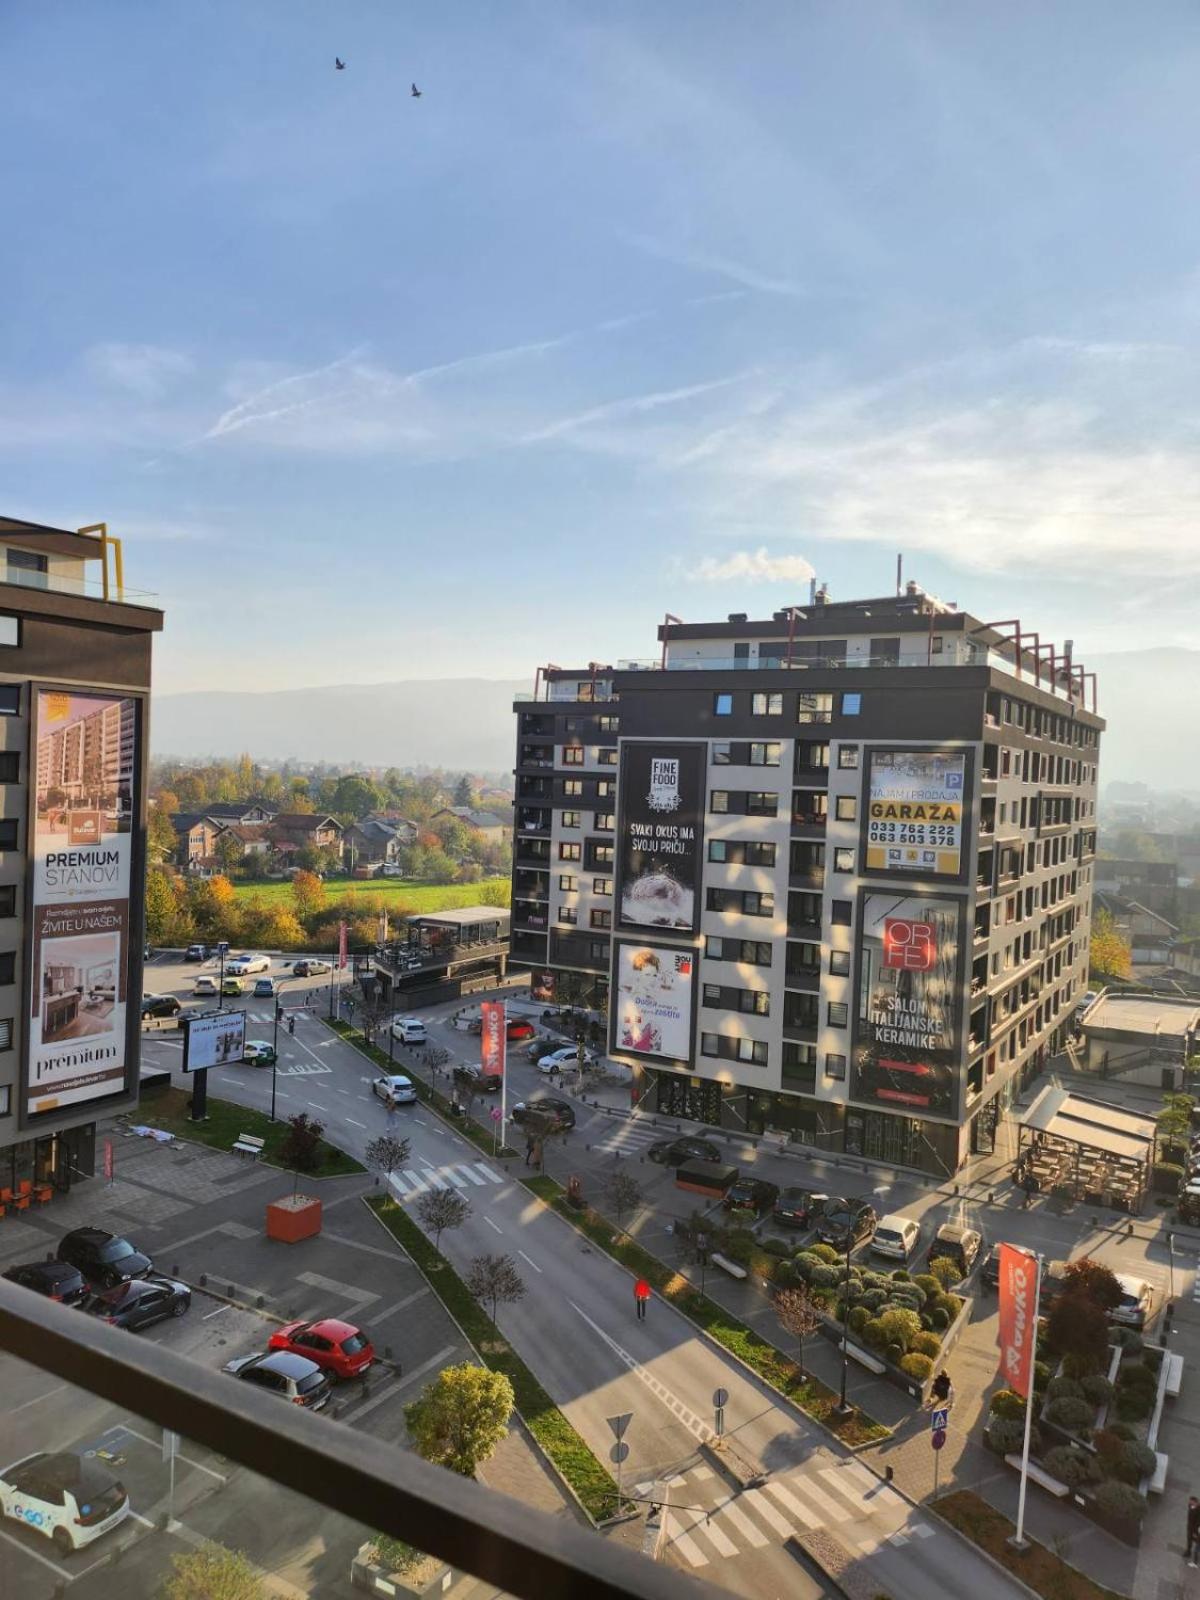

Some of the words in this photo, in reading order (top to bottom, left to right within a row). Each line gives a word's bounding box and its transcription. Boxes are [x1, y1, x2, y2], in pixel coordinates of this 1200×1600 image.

[653, 761, 677, 774] FINE
[653, 774, 676, 785] FOOD
[871, 803, 956, 821] GARAŽA
[630, 823, 653, 837] SVAKI
[655, 825, 678, 839] OKUS
[680, 827, 695, 840] IMA
[871, 822, 896, 832] 033
[900, 824, 925, 834] 762
[929, 825, 954, 835] 222
[632, 838, 658, 851] SVOJU
[870, 832, 895, 842] 063
[900, 834, 925, 844] 503
[46, 851, 119, 867] PREMIUM
[45, 867, 119, 886] STANOVI
[84, 914, 122, 929] NAŠEM
[887, 996, 925, 1014] SALON
[870, 1010, 943, 1034] ITALIJANSKE
[875, 1027, 936, 1050] KERAMIKE
[36, 1047, 117, 1080] premium
